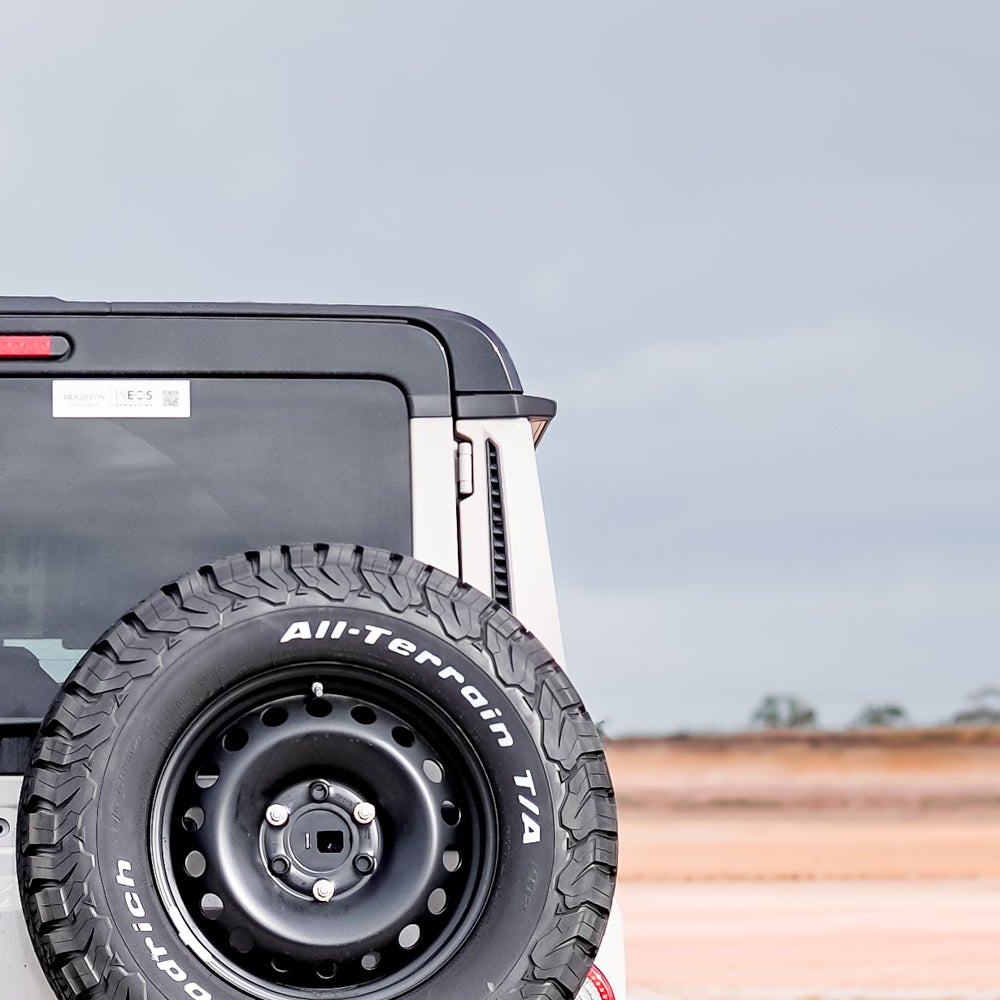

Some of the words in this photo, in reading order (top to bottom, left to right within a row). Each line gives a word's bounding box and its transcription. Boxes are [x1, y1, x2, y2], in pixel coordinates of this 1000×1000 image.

[115, 390, 153, 400] INEOS
[279, 620, 514, 747] All-Terrain
[513, 769, 541, 844] T/A
